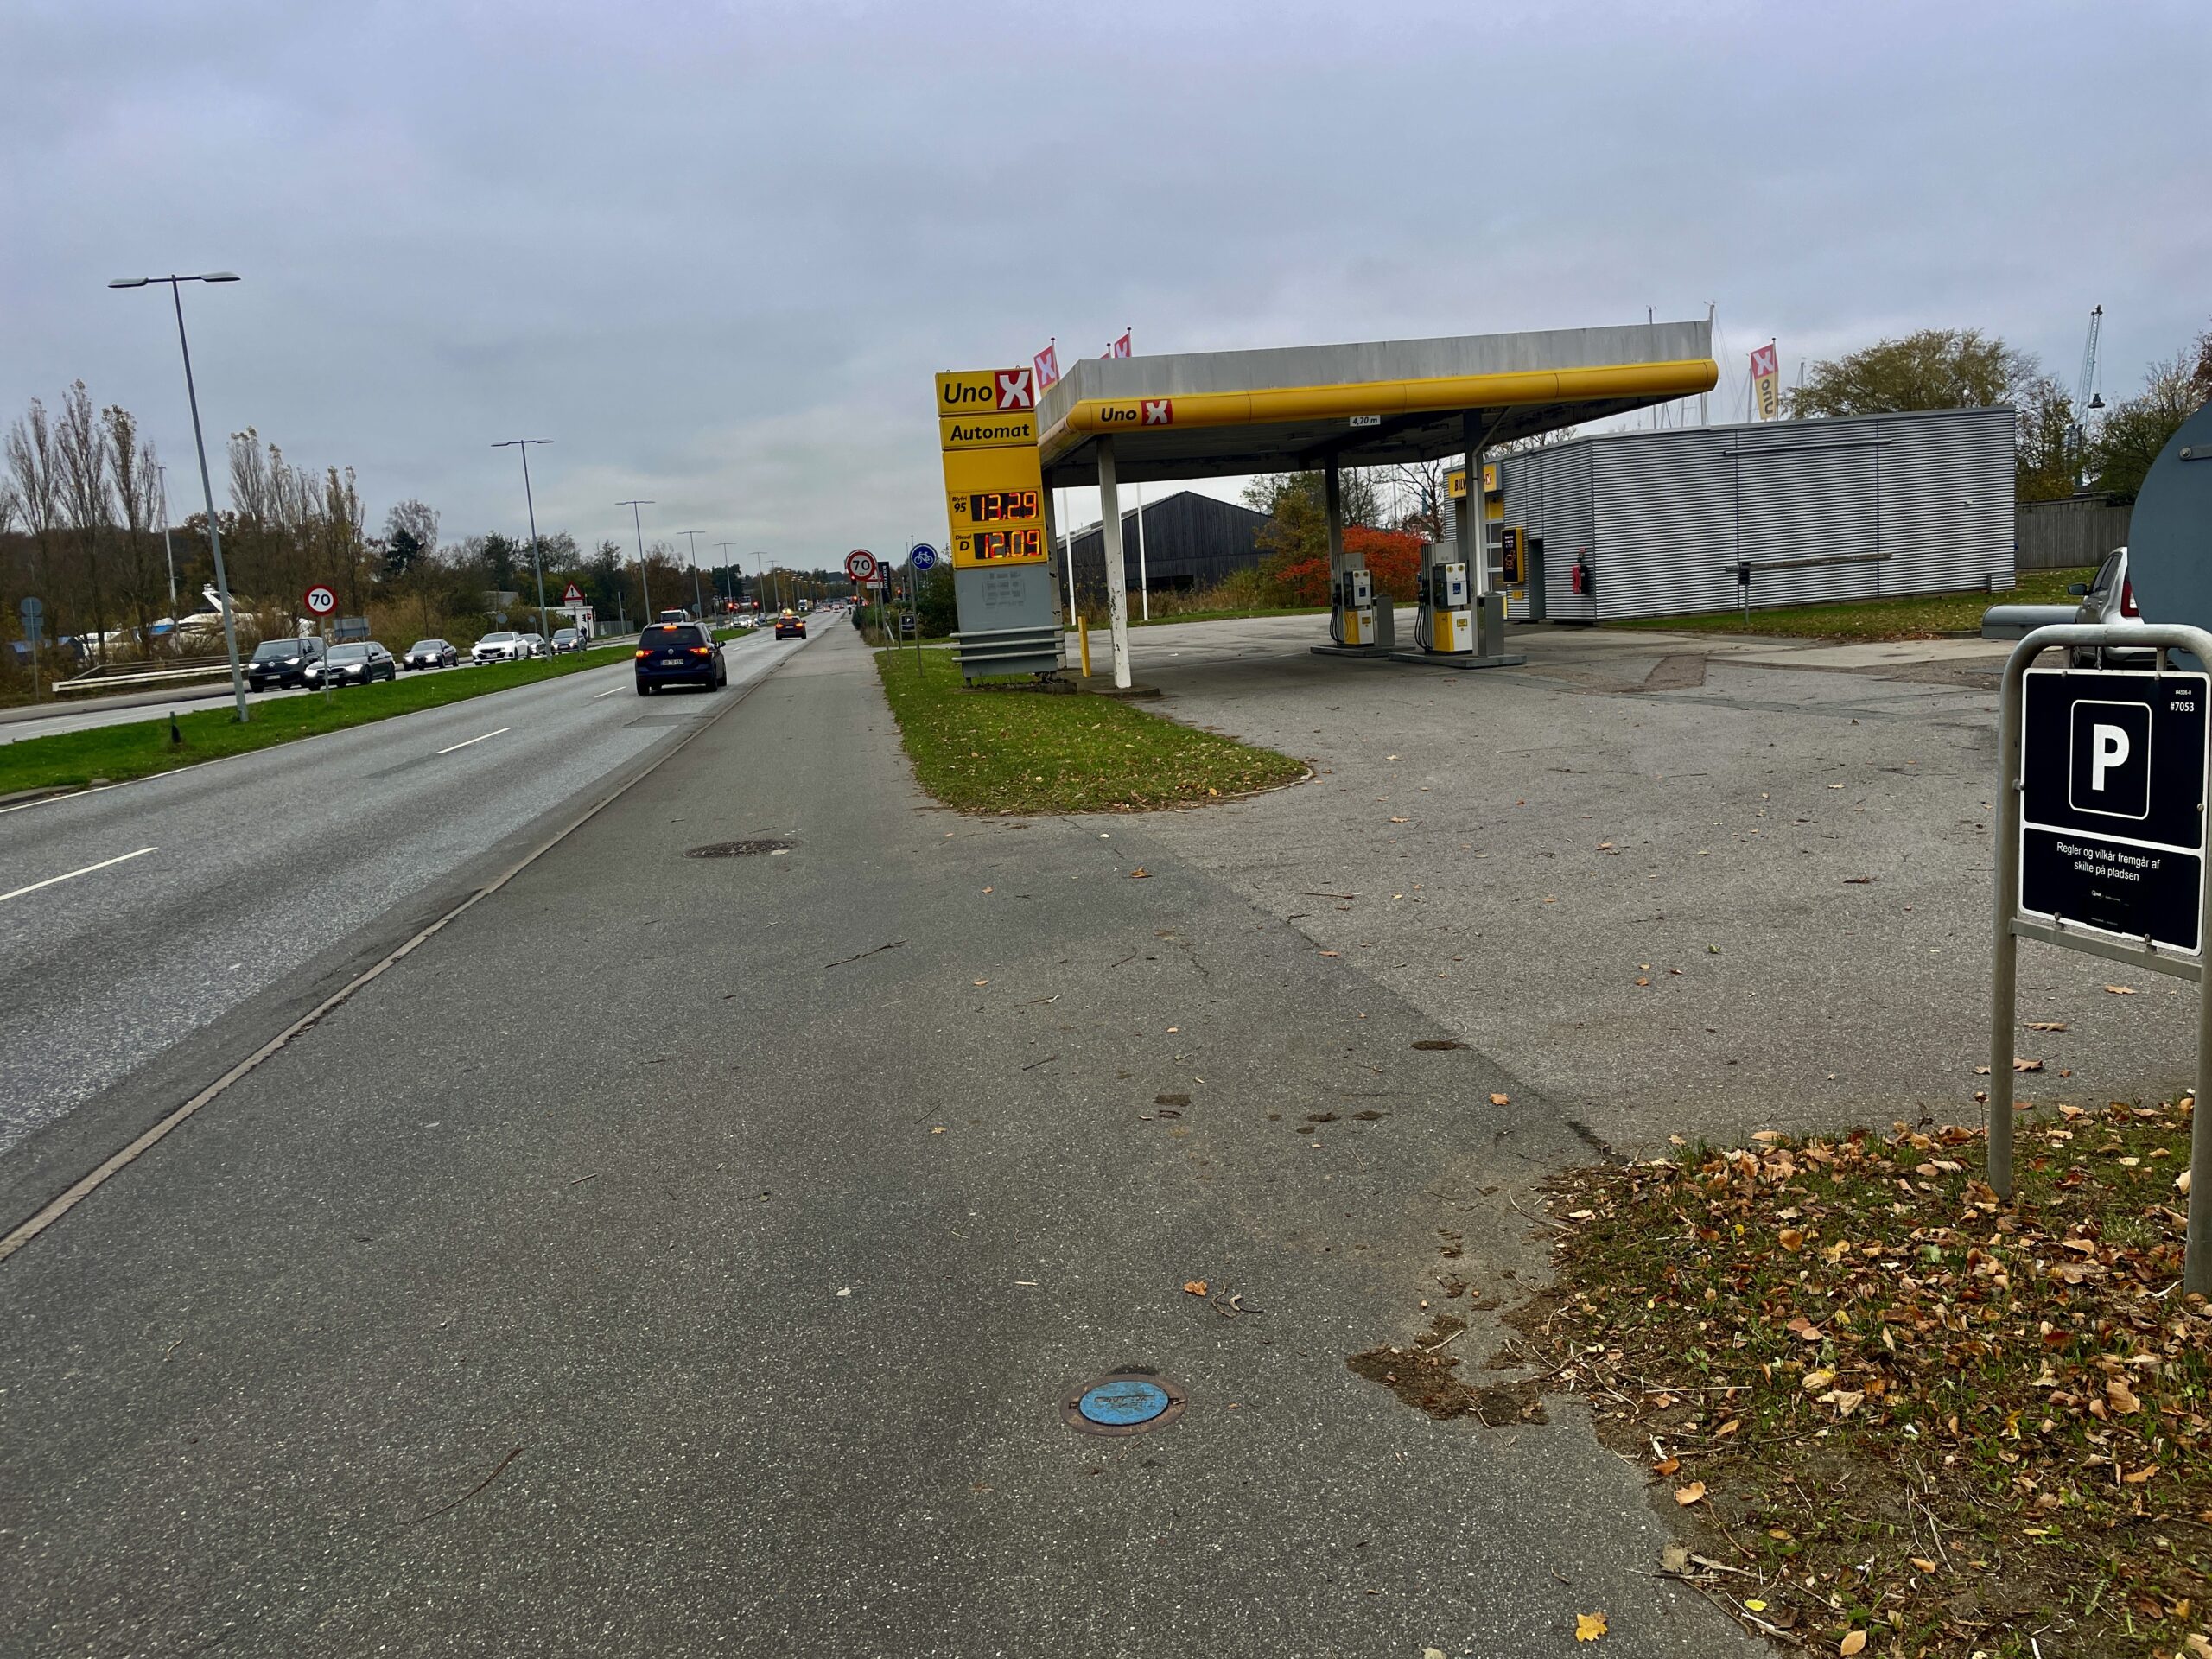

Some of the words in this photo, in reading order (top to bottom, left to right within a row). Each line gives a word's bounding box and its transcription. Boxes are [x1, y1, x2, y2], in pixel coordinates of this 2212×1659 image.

[1036, 353, 1056, 385] X
[1753, 350, 1774, 376] X
[944, 383, 993, 404] Uno
[999, 372, 1031, 409] X
[1762, 379, 1773, 414] Uno
[1101, 407, 1137, 422] Uno
[1145, 400, 1168, 424] X
[950, 423, 1030, 442] Automat
[954, 502, 967, 513] 95
[982, 492, 1037, 521] 13,29
[959, 541, 969, 551] D
[985, 530, 1040, 559] 12,09
[853, 560, 870, 570] 70
[311, 594, 330, 606] 70
[2170, 702, 2195, 712] #7053
[2092, 723, 2130, 791] P
[2056, 842, 2082, 855] Regler
[2083, 849, 2094, 860] og
[2094, 849, 2116, 861] vilkår
[2118, 852, 2150, 868] fremgår
[2152, 859, 2161, 869] af
[2074, 860, 2094, 873] skilte
[2095, 864, 2106, 876] på
[2107, 867, 2139, 881] pladsen
